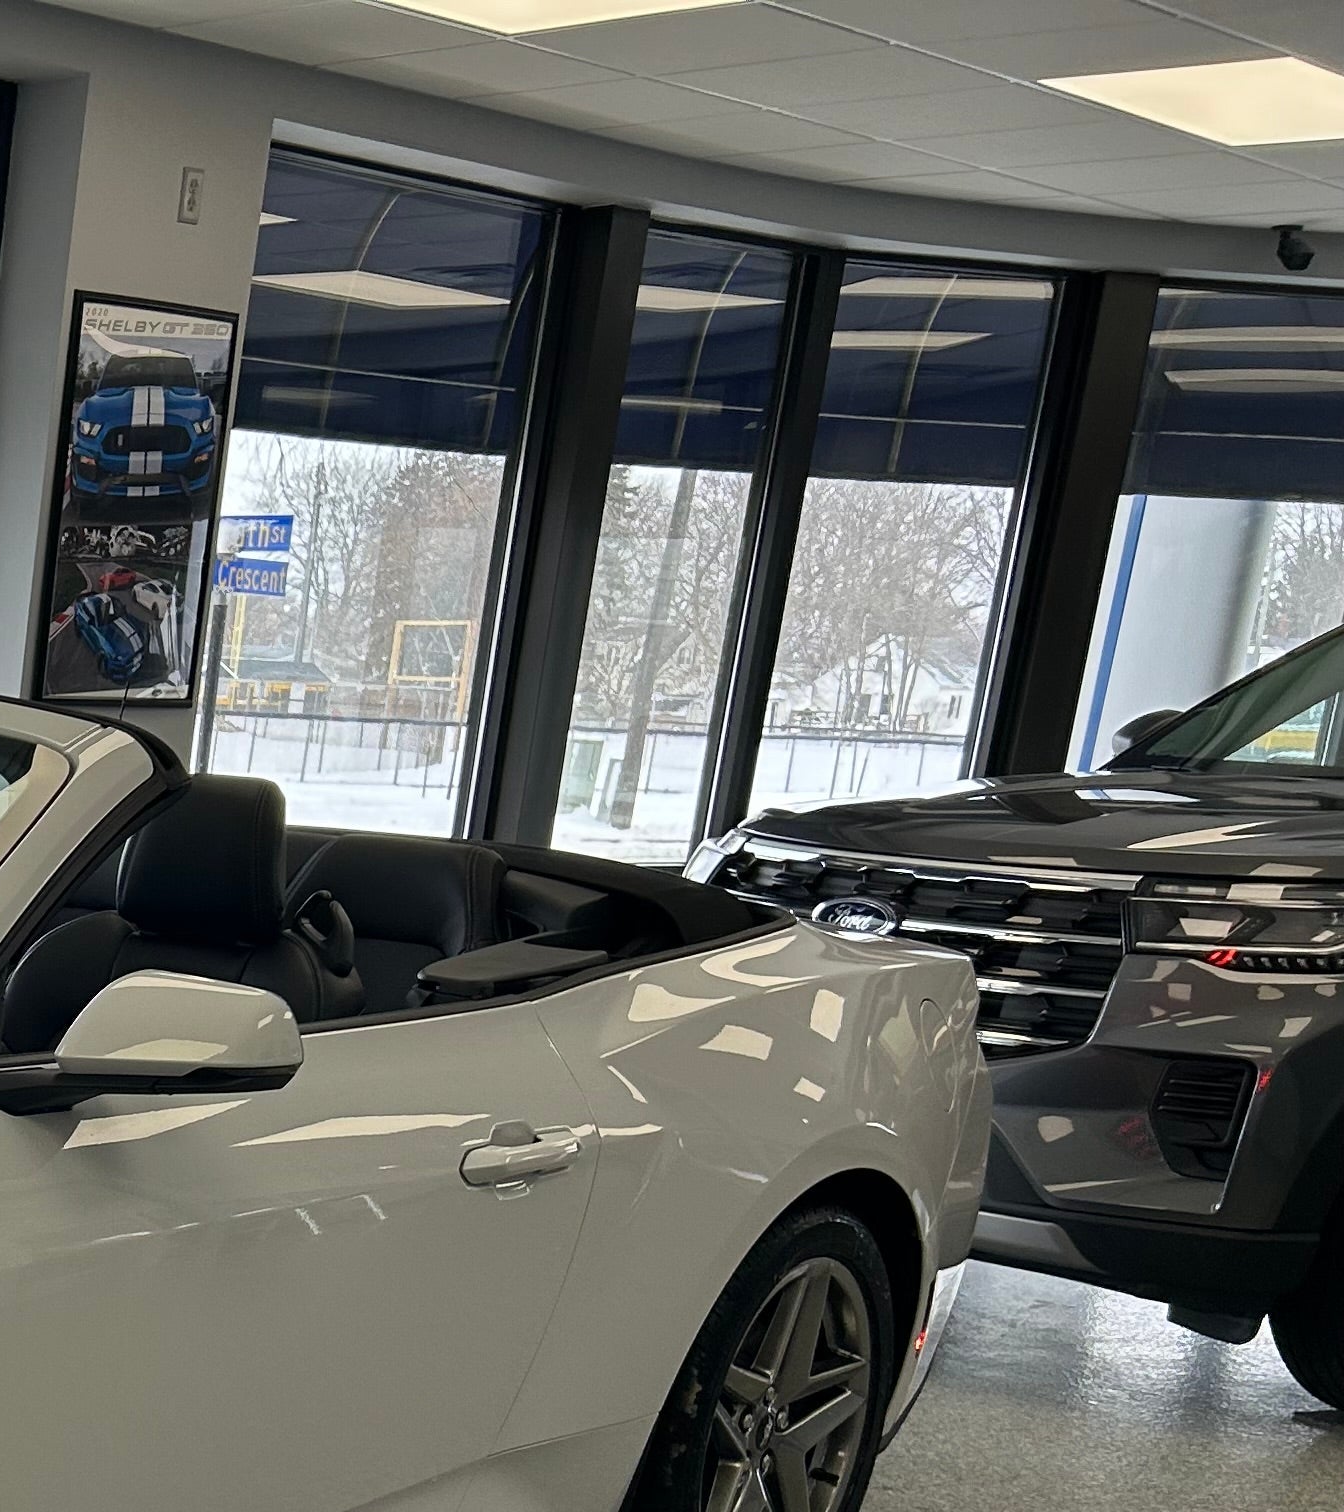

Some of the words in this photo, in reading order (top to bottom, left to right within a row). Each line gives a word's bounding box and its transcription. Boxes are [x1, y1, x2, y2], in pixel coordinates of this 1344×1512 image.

[85, 307, 109, 317] 2020
[84, 318, 161, 333] SHELBY
[218, 560, 286, 593] Crescent
[828, 903, 874, 931] Ford
